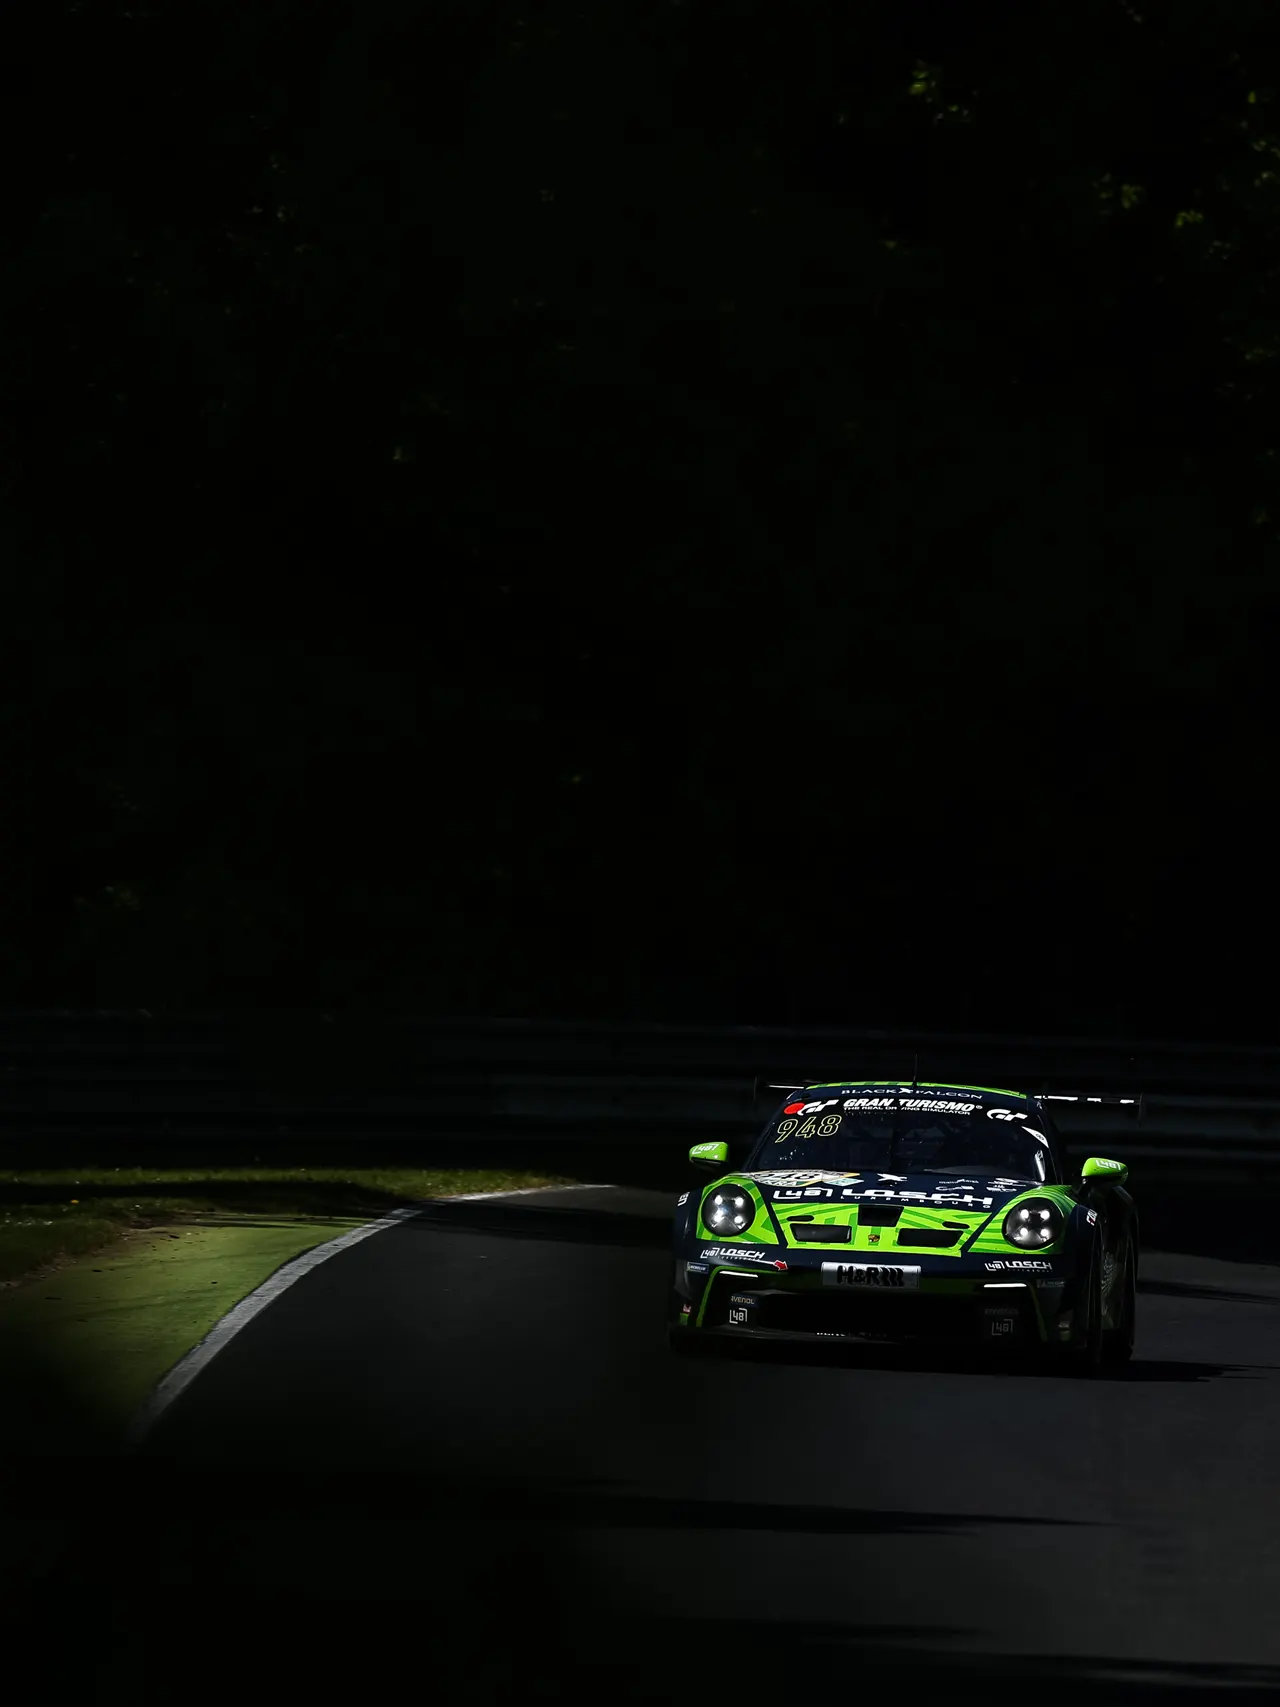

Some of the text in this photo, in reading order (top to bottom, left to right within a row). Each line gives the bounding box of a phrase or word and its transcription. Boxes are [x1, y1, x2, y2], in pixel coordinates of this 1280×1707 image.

[915, 1089, 982, 1100] FALCON
[843, 1098, 894, 1107] GRAN
[922, 1107, 971, 1116] SIMULATOR
[774, 1114, 842, 1144] 948
[842, 1188, 994, 1205] LOSCH
[720, 1247, 765, 1259] LOSCH
[1005, 1260, 1053, 1271] LOSCH
